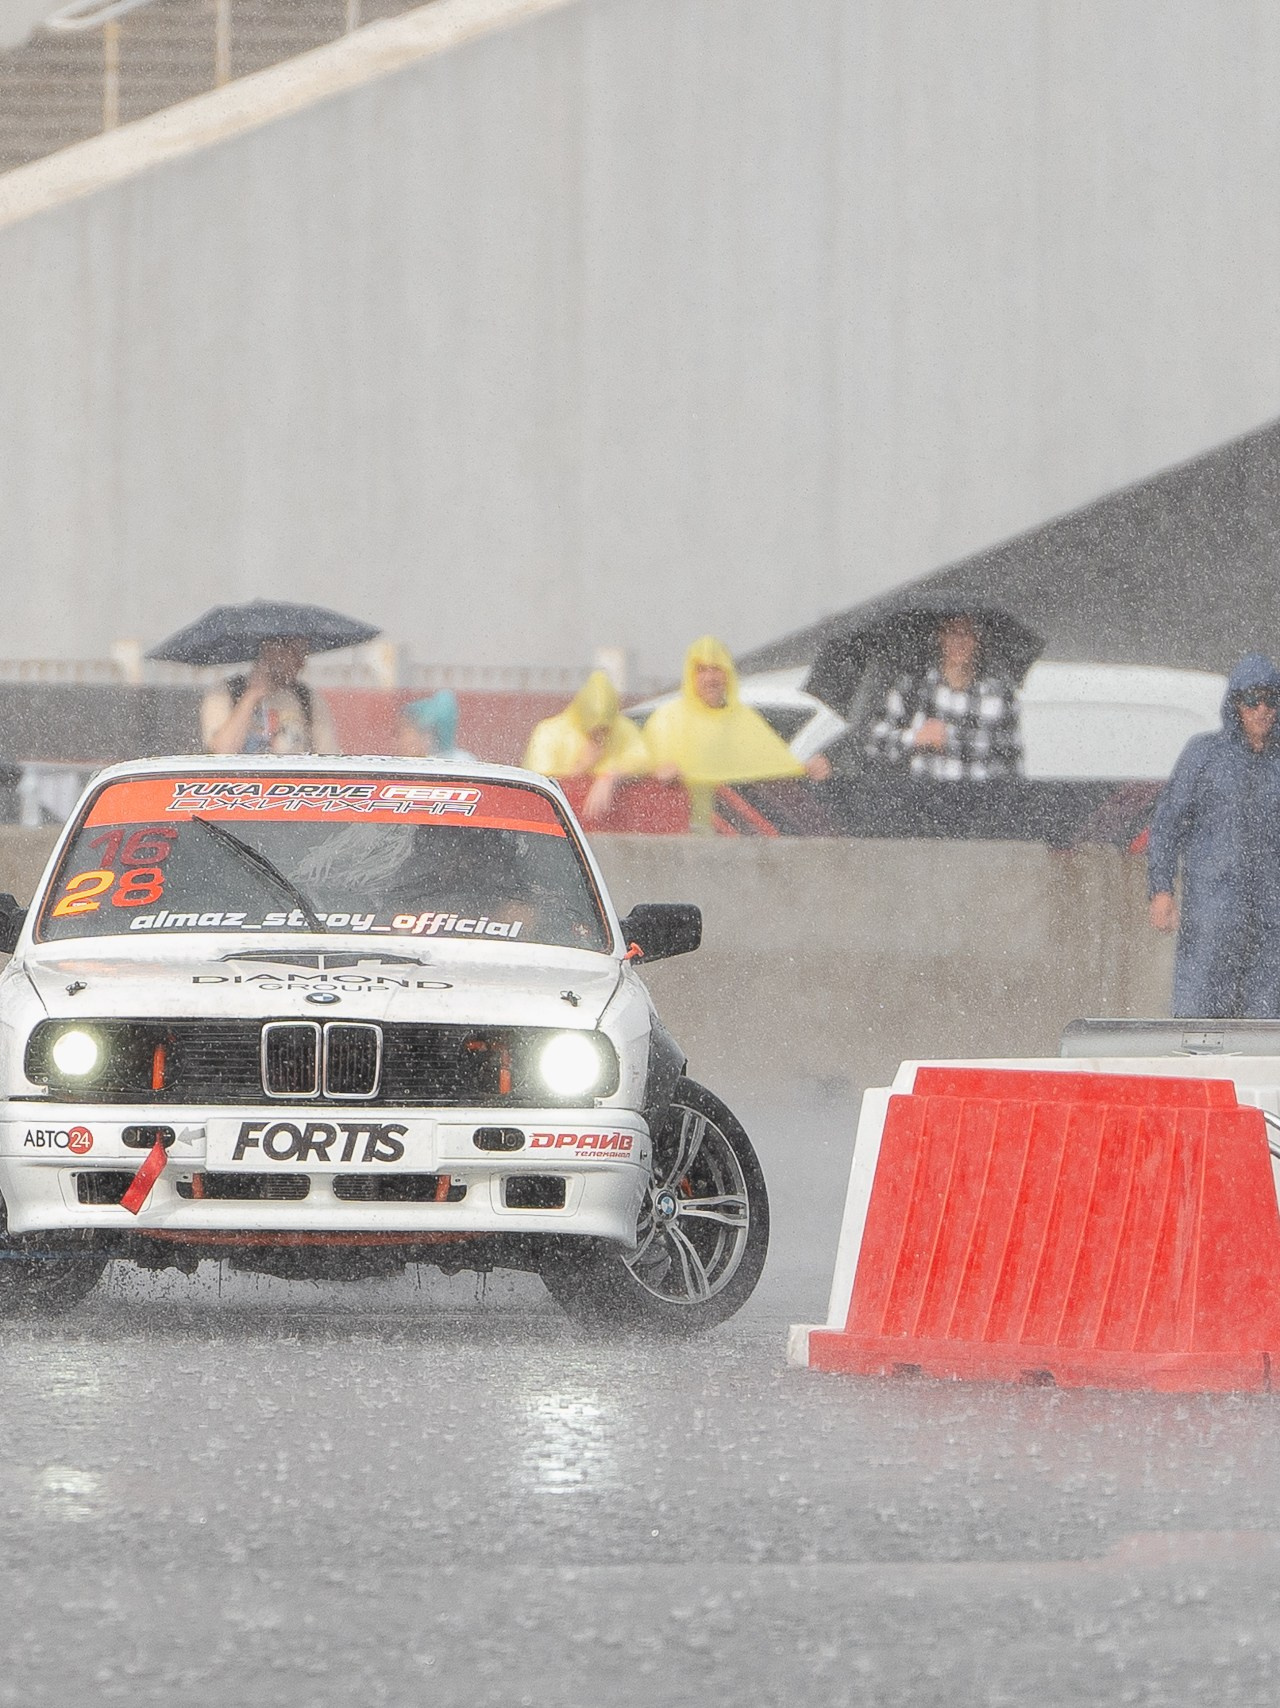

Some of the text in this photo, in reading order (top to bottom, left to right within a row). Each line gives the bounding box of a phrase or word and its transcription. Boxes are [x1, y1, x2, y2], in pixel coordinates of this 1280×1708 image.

[171, 782, 477, 802] YUKA DRIVE FEST
[165, 797, 477, 816] ДЖИМХАНА
[88, 827, 179, 868] 16
[52, 867, 165, 917] 28
[192, 973, 454, 990] DIAMOND
[258, 983, 390, 992] GROUP
[231, 1121, 410, 1163] FORTIS
[528, 1132, 634, 1150] ДРАЙВ
